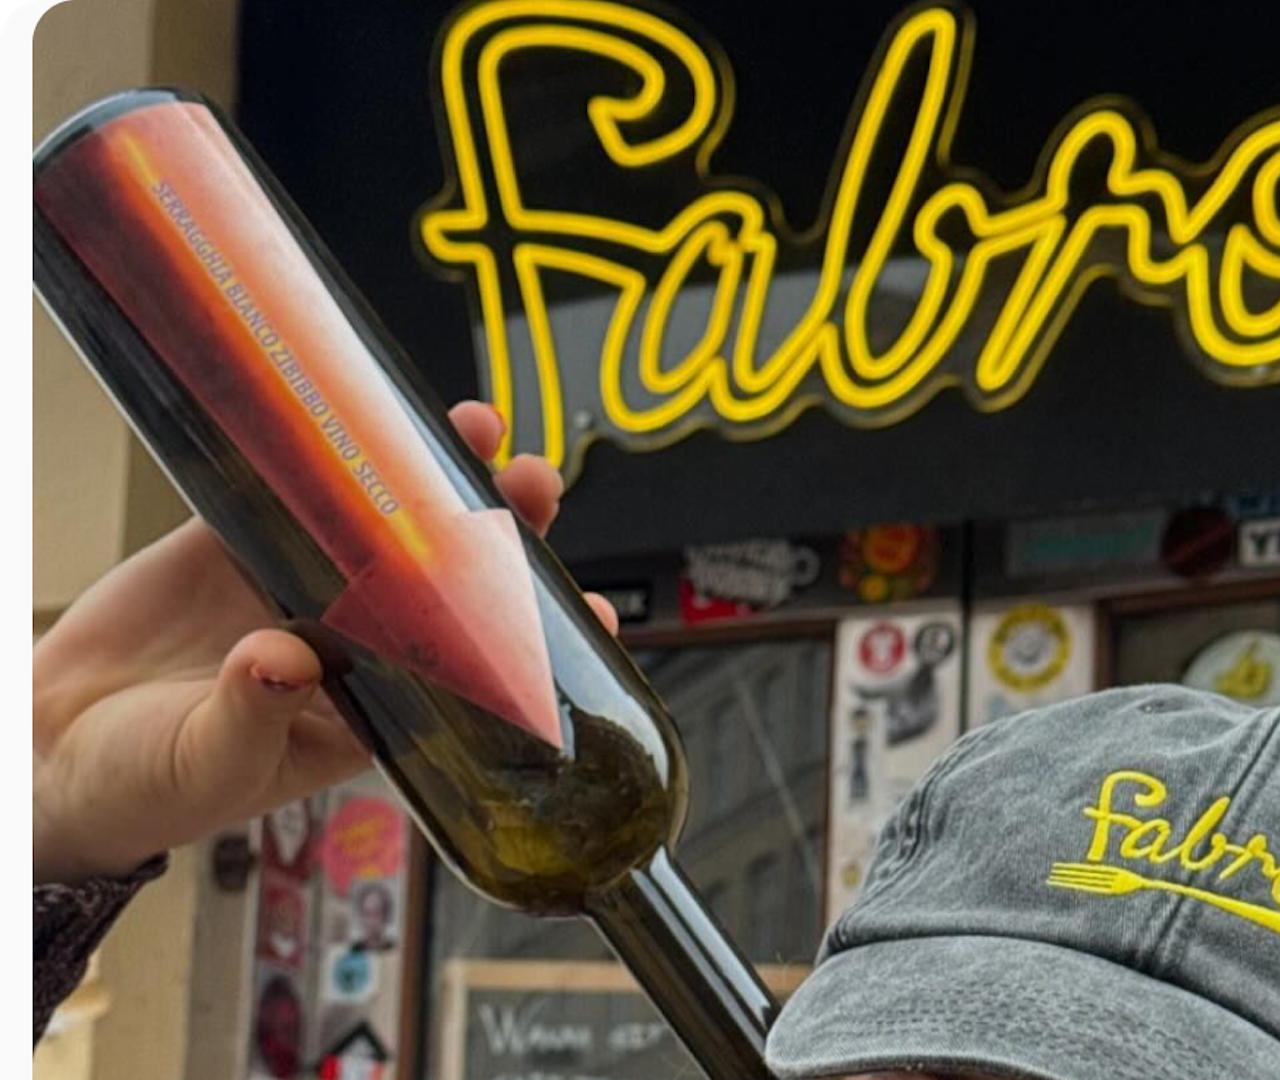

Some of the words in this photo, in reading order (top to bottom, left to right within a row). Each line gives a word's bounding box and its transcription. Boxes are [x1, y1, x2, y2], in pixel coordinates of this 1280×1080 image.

[224, 283, 280, 348] BIANCO
[268, 340, 328, 418] ZIBIBBO
[320, 414, 360, 461] VINO
[353, 460, 399, 515] SECCO
